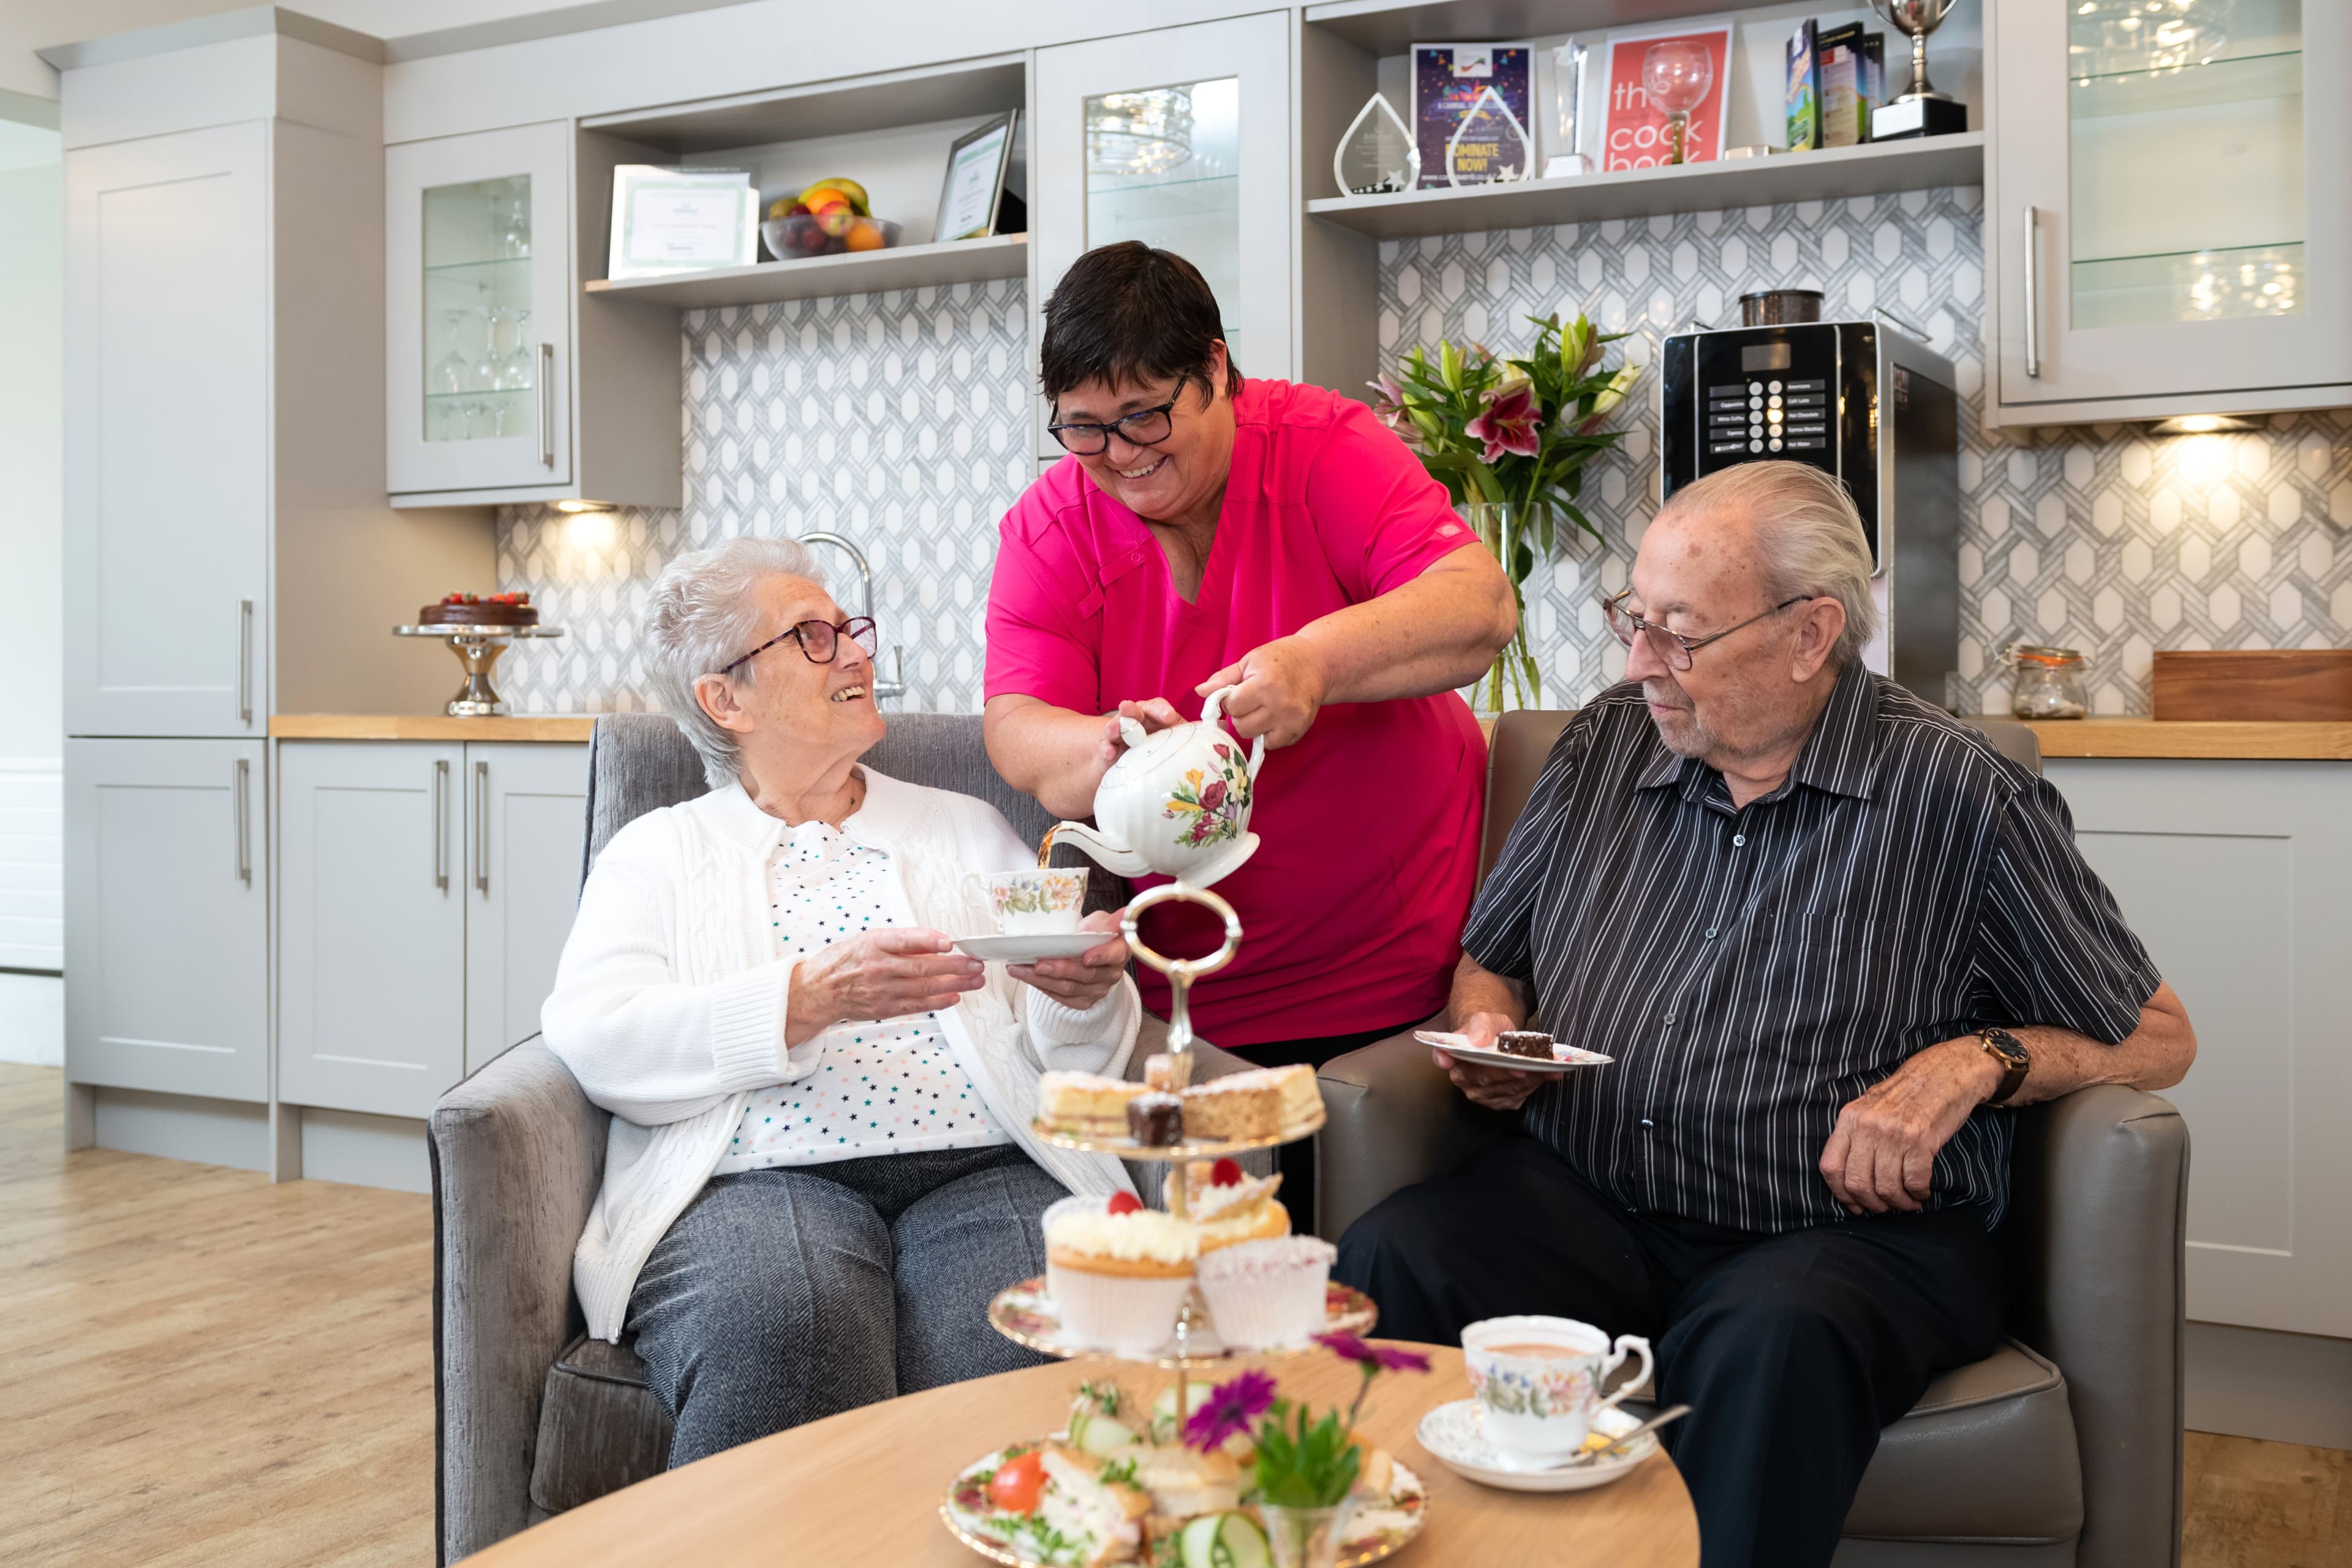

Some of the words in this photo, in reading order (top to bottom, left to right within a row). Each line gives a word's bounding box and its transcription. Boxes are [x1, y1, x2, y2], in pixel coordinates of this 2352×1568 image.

[1615, 81, 1672, 111] the
[1610, 114, 1703, 151] cook
[1457, 158, 1488, 172] NOW!
